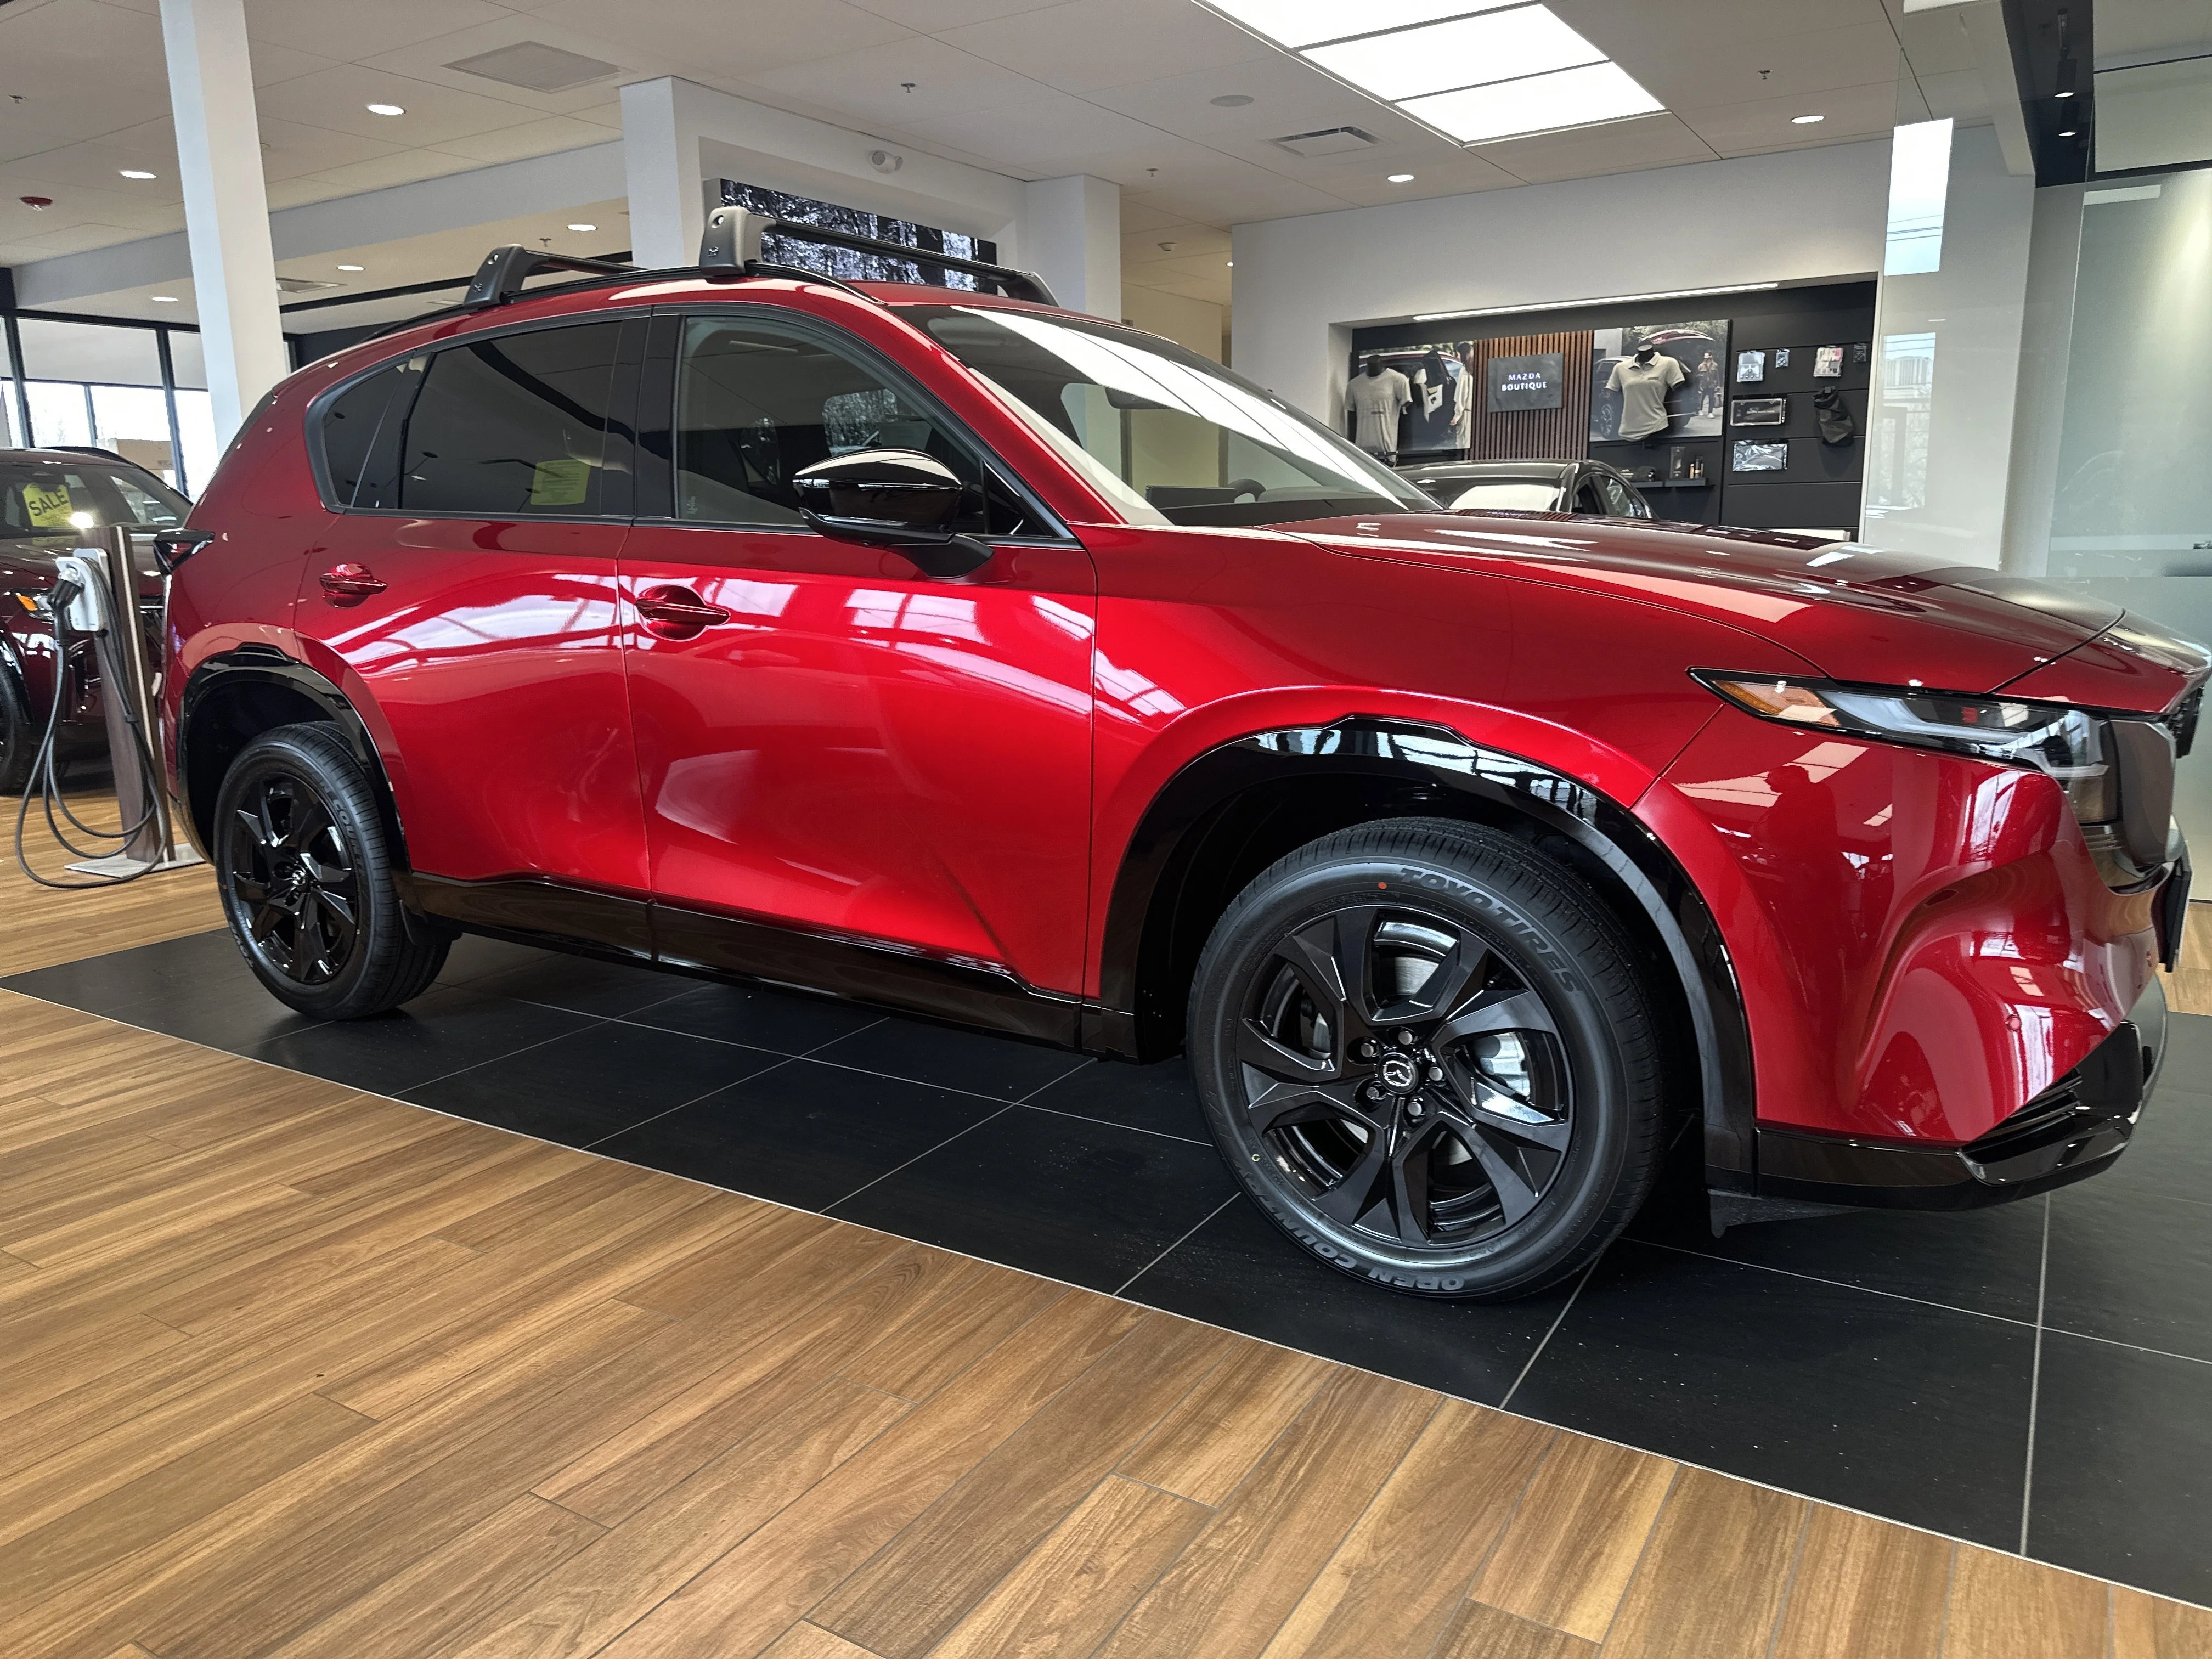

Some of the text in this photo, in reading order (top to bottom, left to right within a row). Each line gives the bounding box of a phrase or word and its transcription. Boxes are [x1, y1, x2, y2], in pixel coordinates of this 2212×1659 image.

[1502, 381, 1547, 391] BOUTIQUE
[1508, 373, 1541, 381] MAZDA
[29, 488, 69, 516] SALE
[1400, 868, 1584, 993] TOYO TIRES
[1232, 1158, 1357, 1269] COUNTRY
[1368, 1266, 1465, 1291] OPEN
